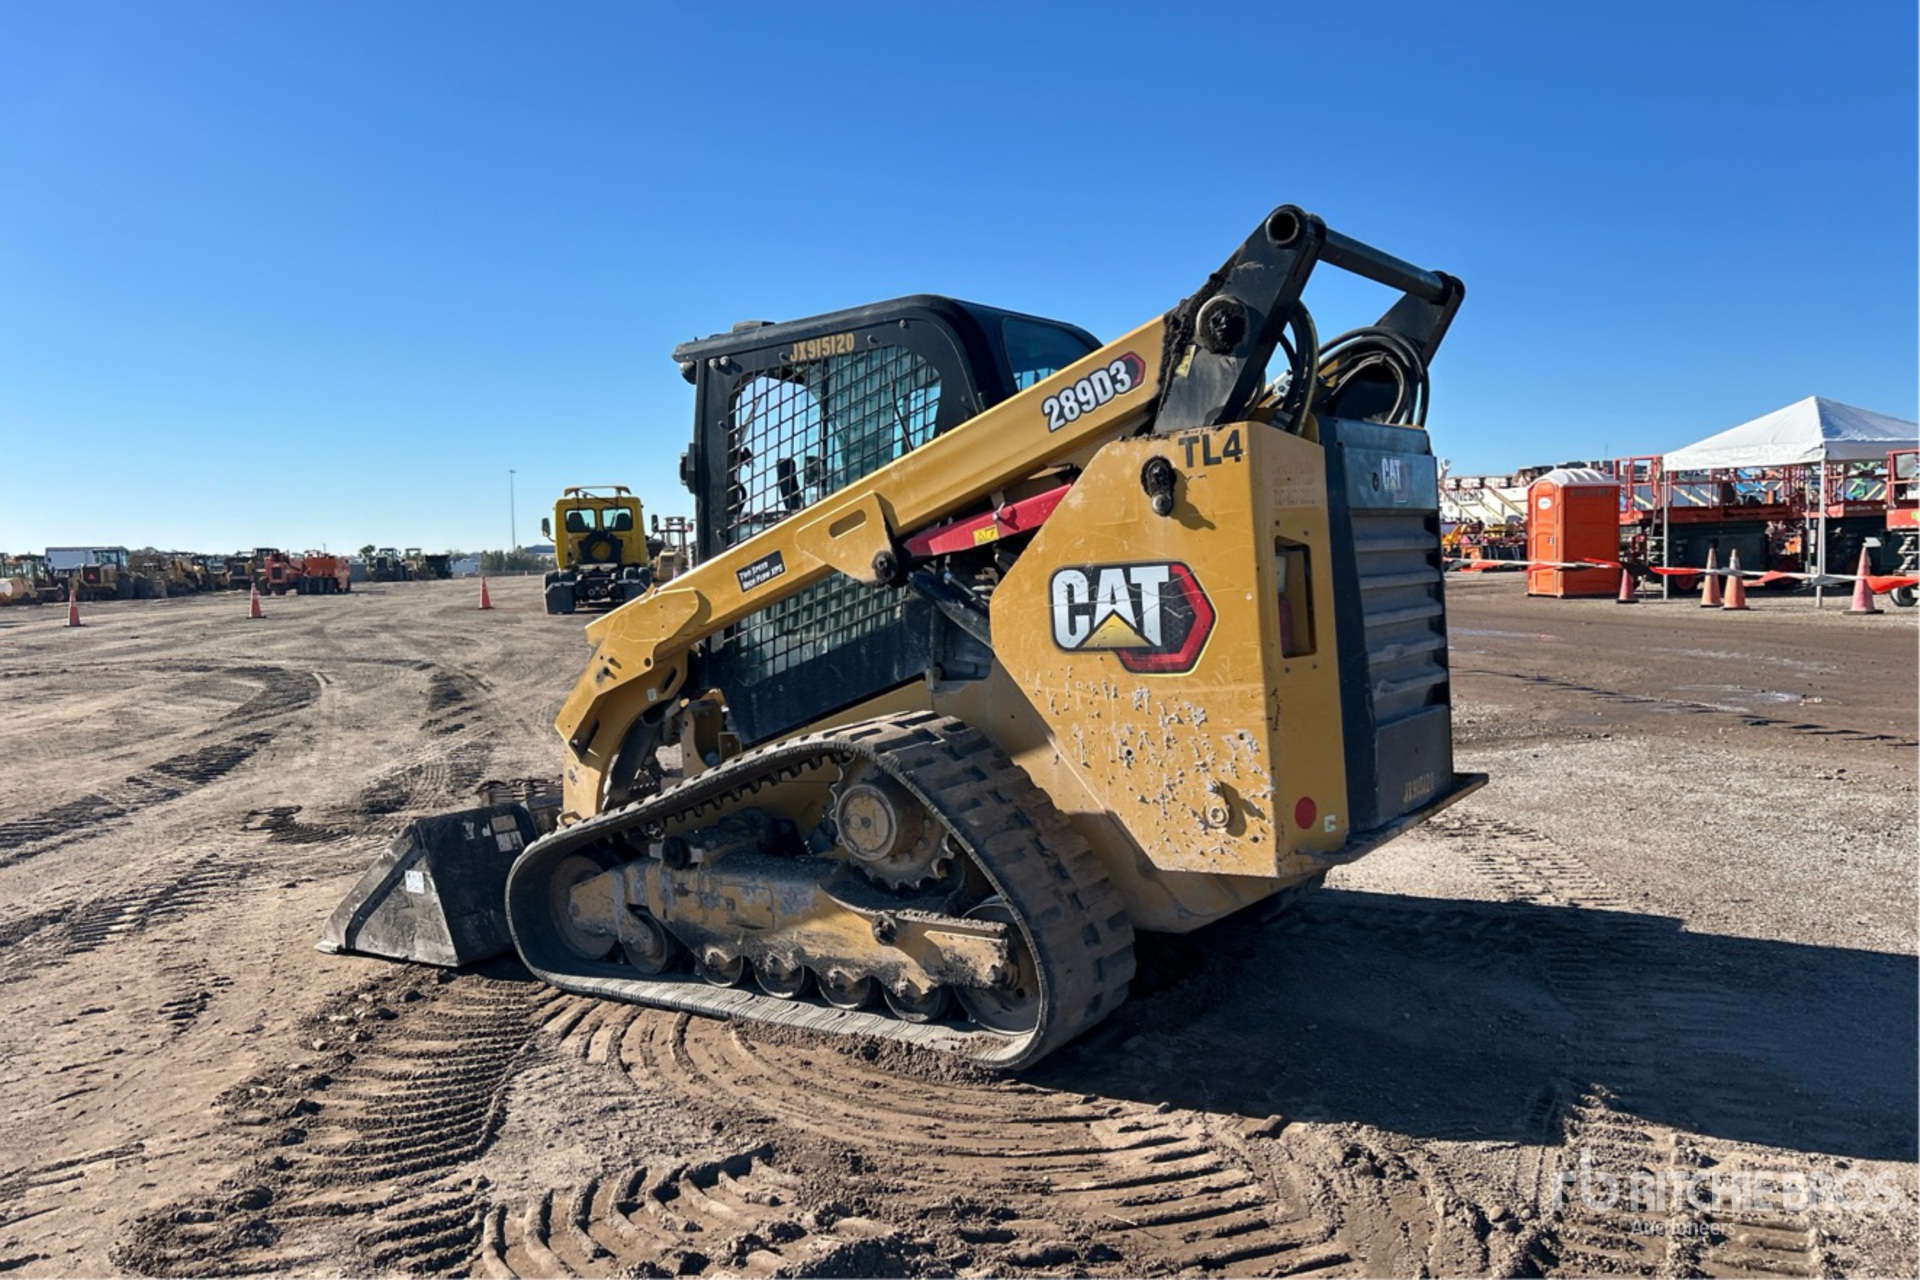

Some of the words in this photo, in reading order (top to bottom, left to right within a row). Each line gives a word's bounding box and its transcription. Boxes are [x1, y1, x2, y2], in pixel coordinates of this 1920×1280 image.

[790, 332, 855, 362] JX915120
[1042, 359, 1133, 432] 289D3
[1178, 429, 1243, 468] TL4
[1381, 457, 1402, 491] CAT
[1052, 565, 1169, 649] CAT
